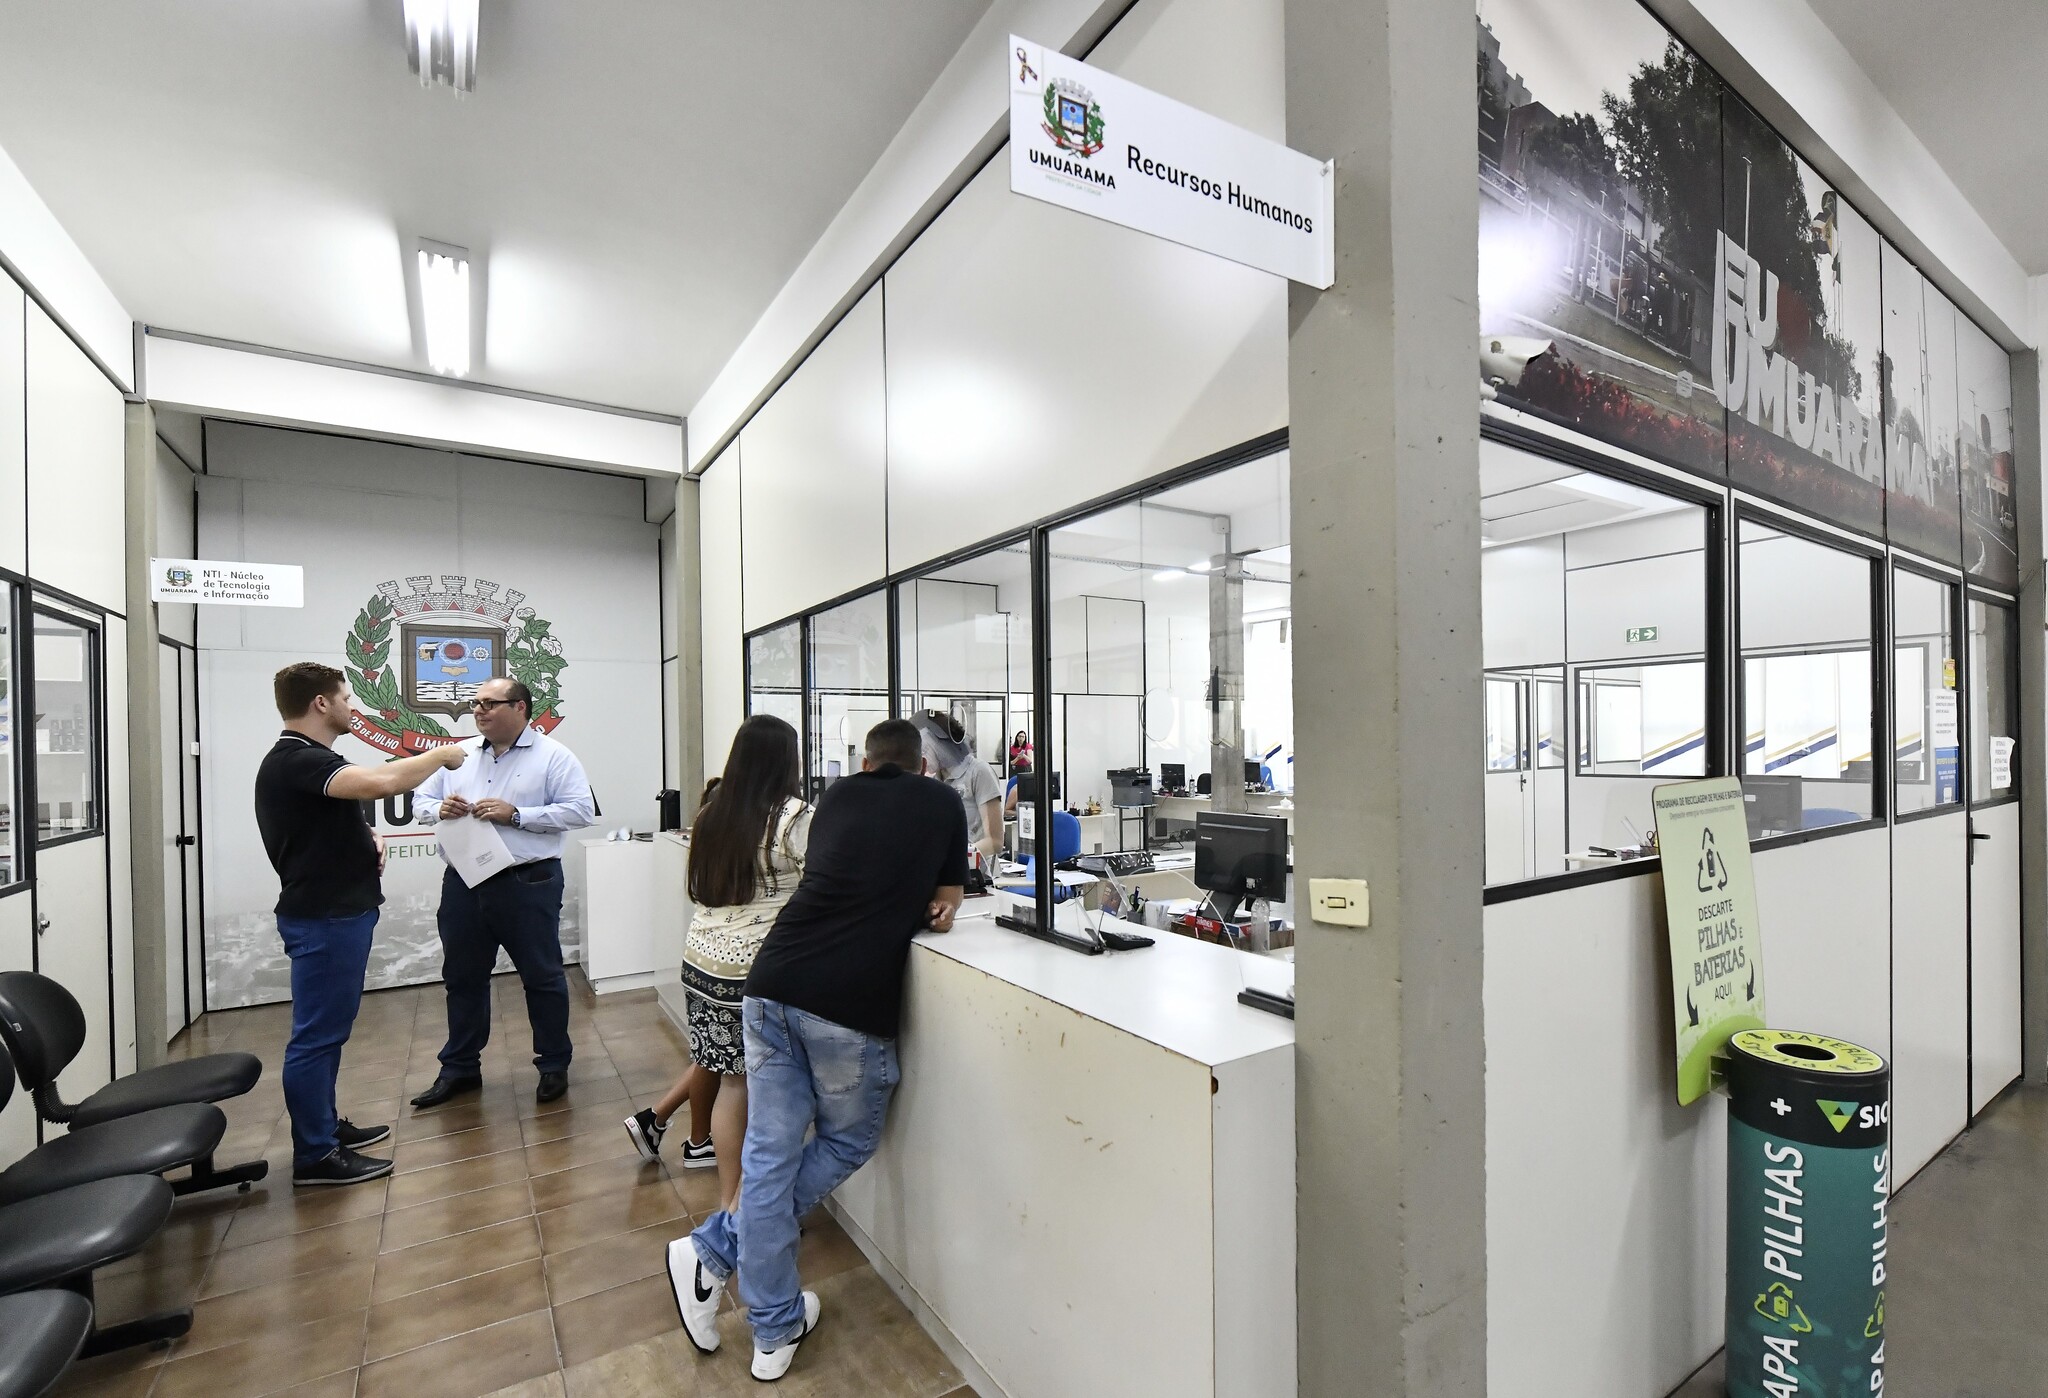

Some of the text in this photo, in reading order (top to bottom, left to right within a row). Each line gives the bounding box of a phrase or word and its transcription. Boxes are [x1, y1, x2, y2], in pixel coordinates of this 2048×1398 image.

[1029, 148, 1116, 190] UMUARAMA
[1127, 144, 1313, 234] Recursos Humanos
[1711, 229, 1780, 350] EU
[1711, 318, 1935, 508] UMUARAMA
[203, 570, 221, 579] NTI
[230, 570, 264, 581] Núcleo
[203, 580, 271, 593] de Tecnologia
[211, 590, 269, 601] Informação
[351, 716, 365, 731] 25
[360, 727, 371, 737] DE
[369, 733, 400, 750] JULHO
[1656, 799, 1679, 810] PROGRAMA
[1679, 798, 1685, 806] DE
[1685, 795, 1707, 805] RECICLAGEM
[1698, 899, 1733, 921] DESCARTE
[1697, 918, 1744, 952] PILHAS E
[1694, 945, 1746, 987] BATERIAS
[1714, 982, 1733, 1002] AQUI
[1779, 1031, 1874, 1067] BATERIAS
[1763, 1141, 1804, 1398] APA PILHAS
